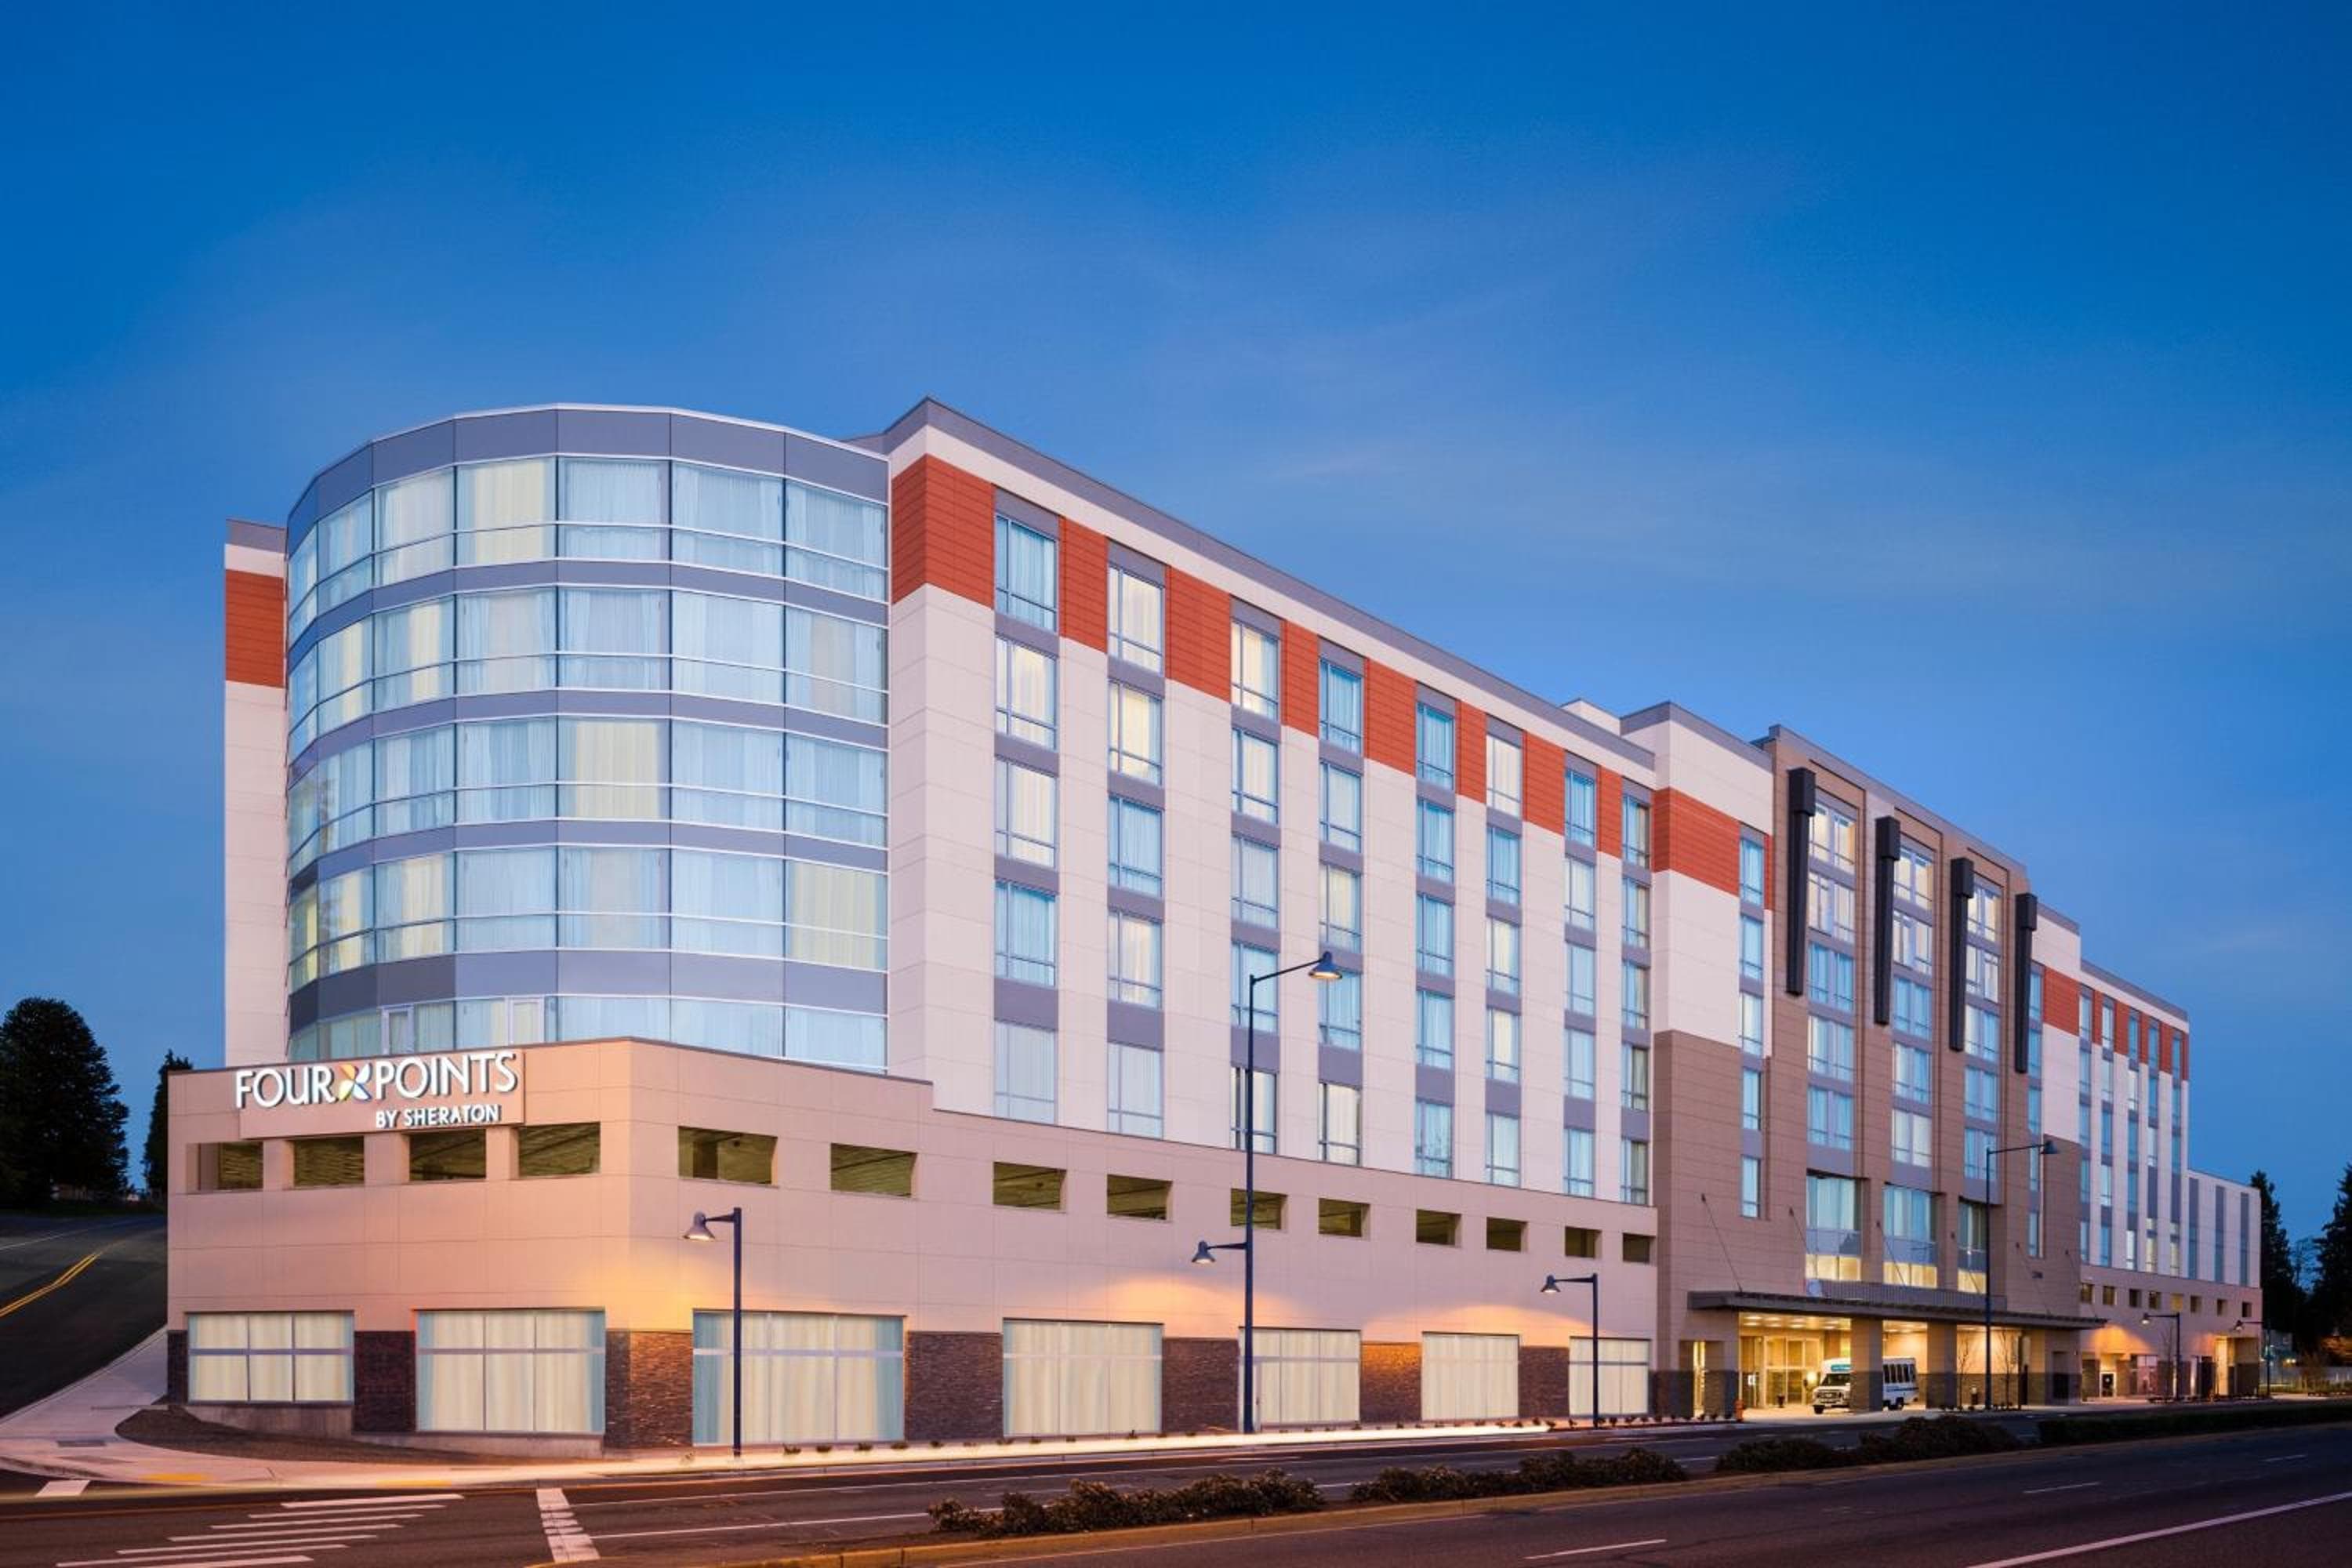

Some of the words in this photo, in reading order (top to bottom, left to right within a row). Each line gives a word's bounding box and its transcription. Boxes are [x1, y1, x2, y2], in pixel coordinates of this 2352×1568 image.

[235, 1064, 335, 1109] FOUR
[376, 1051, 517, 1100] POINTS
[376, 1112, 398, 1129] BY
[404, 1104, 500, 1127] SHERATON
